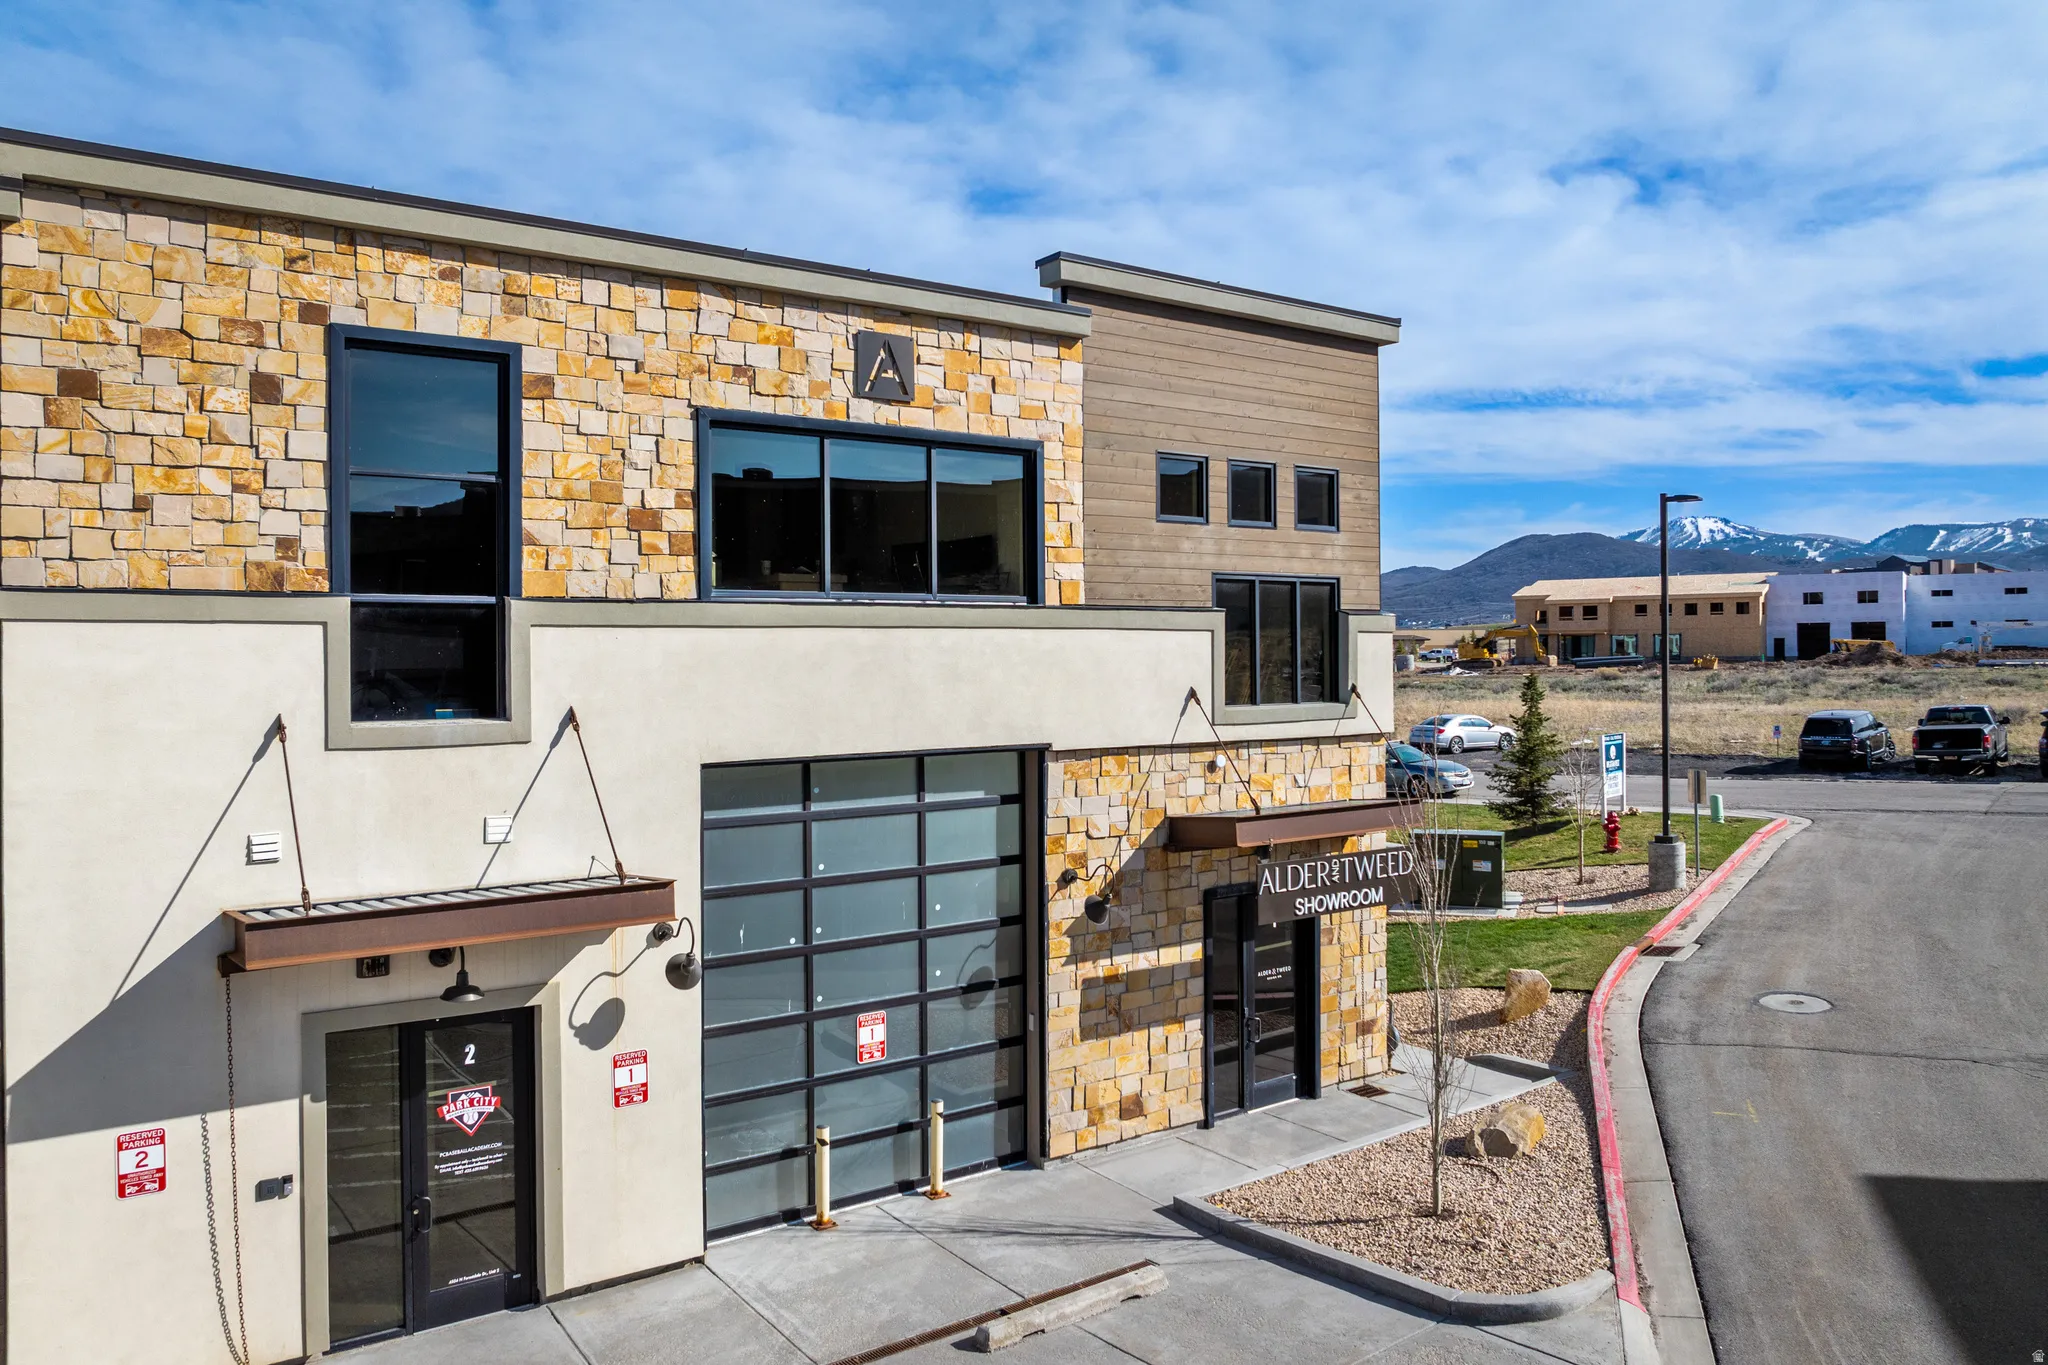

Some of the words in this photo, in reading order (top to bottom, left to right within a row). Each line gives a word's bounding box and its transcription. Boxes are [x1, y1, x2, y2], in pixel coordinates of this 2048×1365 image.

[1259, 860, 1331, 896] ALDER
[1331, 859, 1340, 883] AND
[1340, 850, 1414, 883] TWEED
[1295, 886, 1384, 916] SHOWROOM
[1257, 969, 1272, 977] ALDER
[1276, 965, 1292, 973] TWEED
[870, 1028, 874, 1041] 1
[464, 1043, 476, 1065] 2
[615, 1050, 646, 1062] RESERVED
[616, 1057, 644, 1068] PARKING
[628, 1068, 633, 1083] 1
[442, 1098, 470, 1115] PARK
[473, 1096, 498, 1106] CITY
[120, 1129, 164, 1143] RESERVED
[122, 1137, 161, 1150] PARKING
[439, 1142, 503, 1158] PCBASEBALLACADEMY.COM
[135, 1150, 149, 1169] 2
